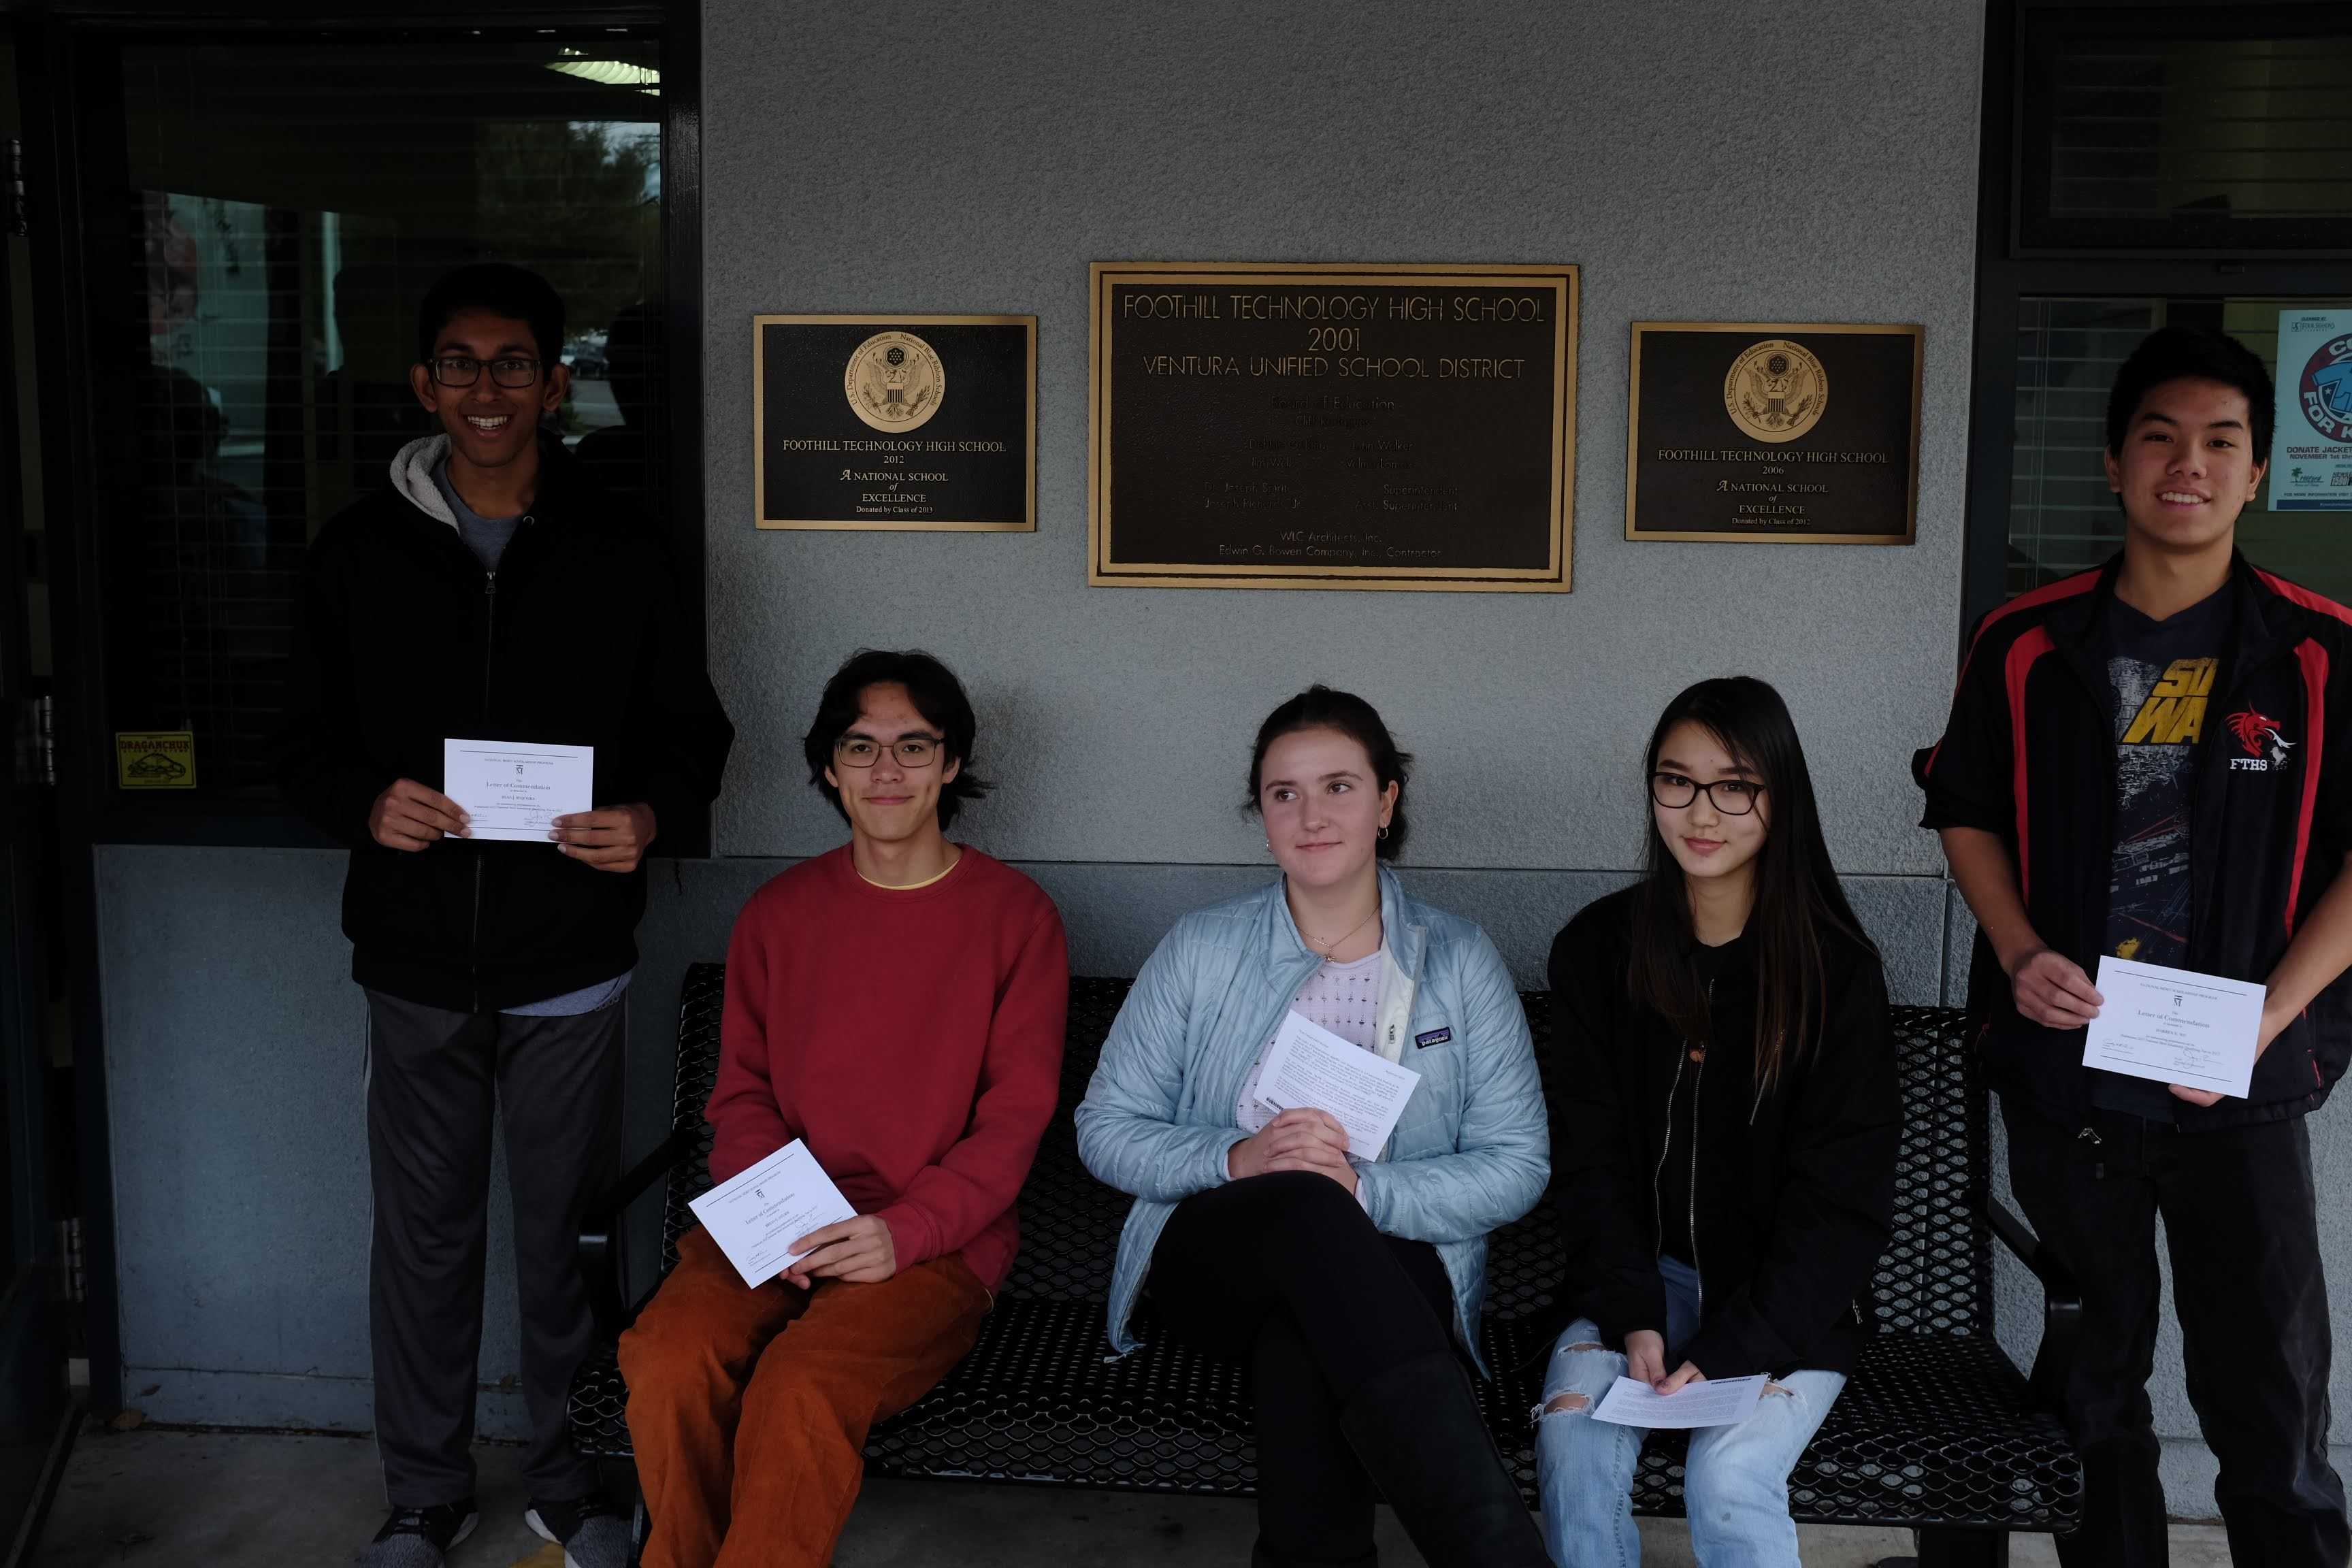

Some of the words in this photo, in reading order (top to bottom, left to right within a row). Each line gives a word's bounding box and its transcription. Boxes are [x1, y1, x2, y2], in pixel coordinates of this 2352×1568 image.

[1124, 295, 1221, 319] FOOTHILL
[1230, 295, 1379, 321] TECHNOLOGY
[1388, 297, 1443, 321] HIGH
[1454, 297, 1545, 322] SCHOOL
[862, 334, 892, 347] Education
[900, 333, 924, 349] National
[1307, 327, 1360, 352] 2001
[1744, 342, 1774, 358] Education
[1782, 342, 1808, 357] National
[1143, 355, 1241, 376] VENTURA
[1250, 356, 1329, 376] UNIFIED
[1339, 357, 1430, 378] SCHOOL
[1439, 358, 1525, 379] DISTRICT
[1333, 397, 1395, 410] Education
[783, 440, 840, 451] FOOTHILL
[844, 440, 923, 451] TECHNOLOGY
[926, 441, 956, 451] HIGH
[959, 441, 1007, 452] SCHOOL
[883, 455, 904, 463] 2012
[1658, 450, 1718, 461] FOOTHILL
[1720, 451, 1803, 462] TECHNOLOGY
[1807, 452, 1838, 462] HIGH
[1840, 453, 1890, 463] SCHOOL
[854, 472, 905, 481] NATIONAL
[909, 473, 949, 481] SCHOOL
[1763, 466, 1784, 474] 2006
[889, 483, 898, 491] of
[1731, 483, 1784, 492] NATIONAL
[1787, 484, 1829, 493] SCHOOL
[862, 494, 926, 502] EXCELLENCE
[1740, 505, 1805, 514] EXCELLENCE
[1759, 517, 1767, 525] by
[1279, 531, 1305, 542] WLC
[1220, 544, 1248, 556] Edwin
[1252, 544, 1264, 556] G.
[1269, 545, 1302, 556] Bowen
[1386, 546, 1443, 558] Contractor
[120, 740, 190, 749] DRAGANCHUK
[2230, 758, 2268, 771] FTHS
[2138, 1009, 2155, 1019] Letter
[2164, 1014, 2210, 1028] Commendation
[763, 1192, 795, 1214] Commendation
